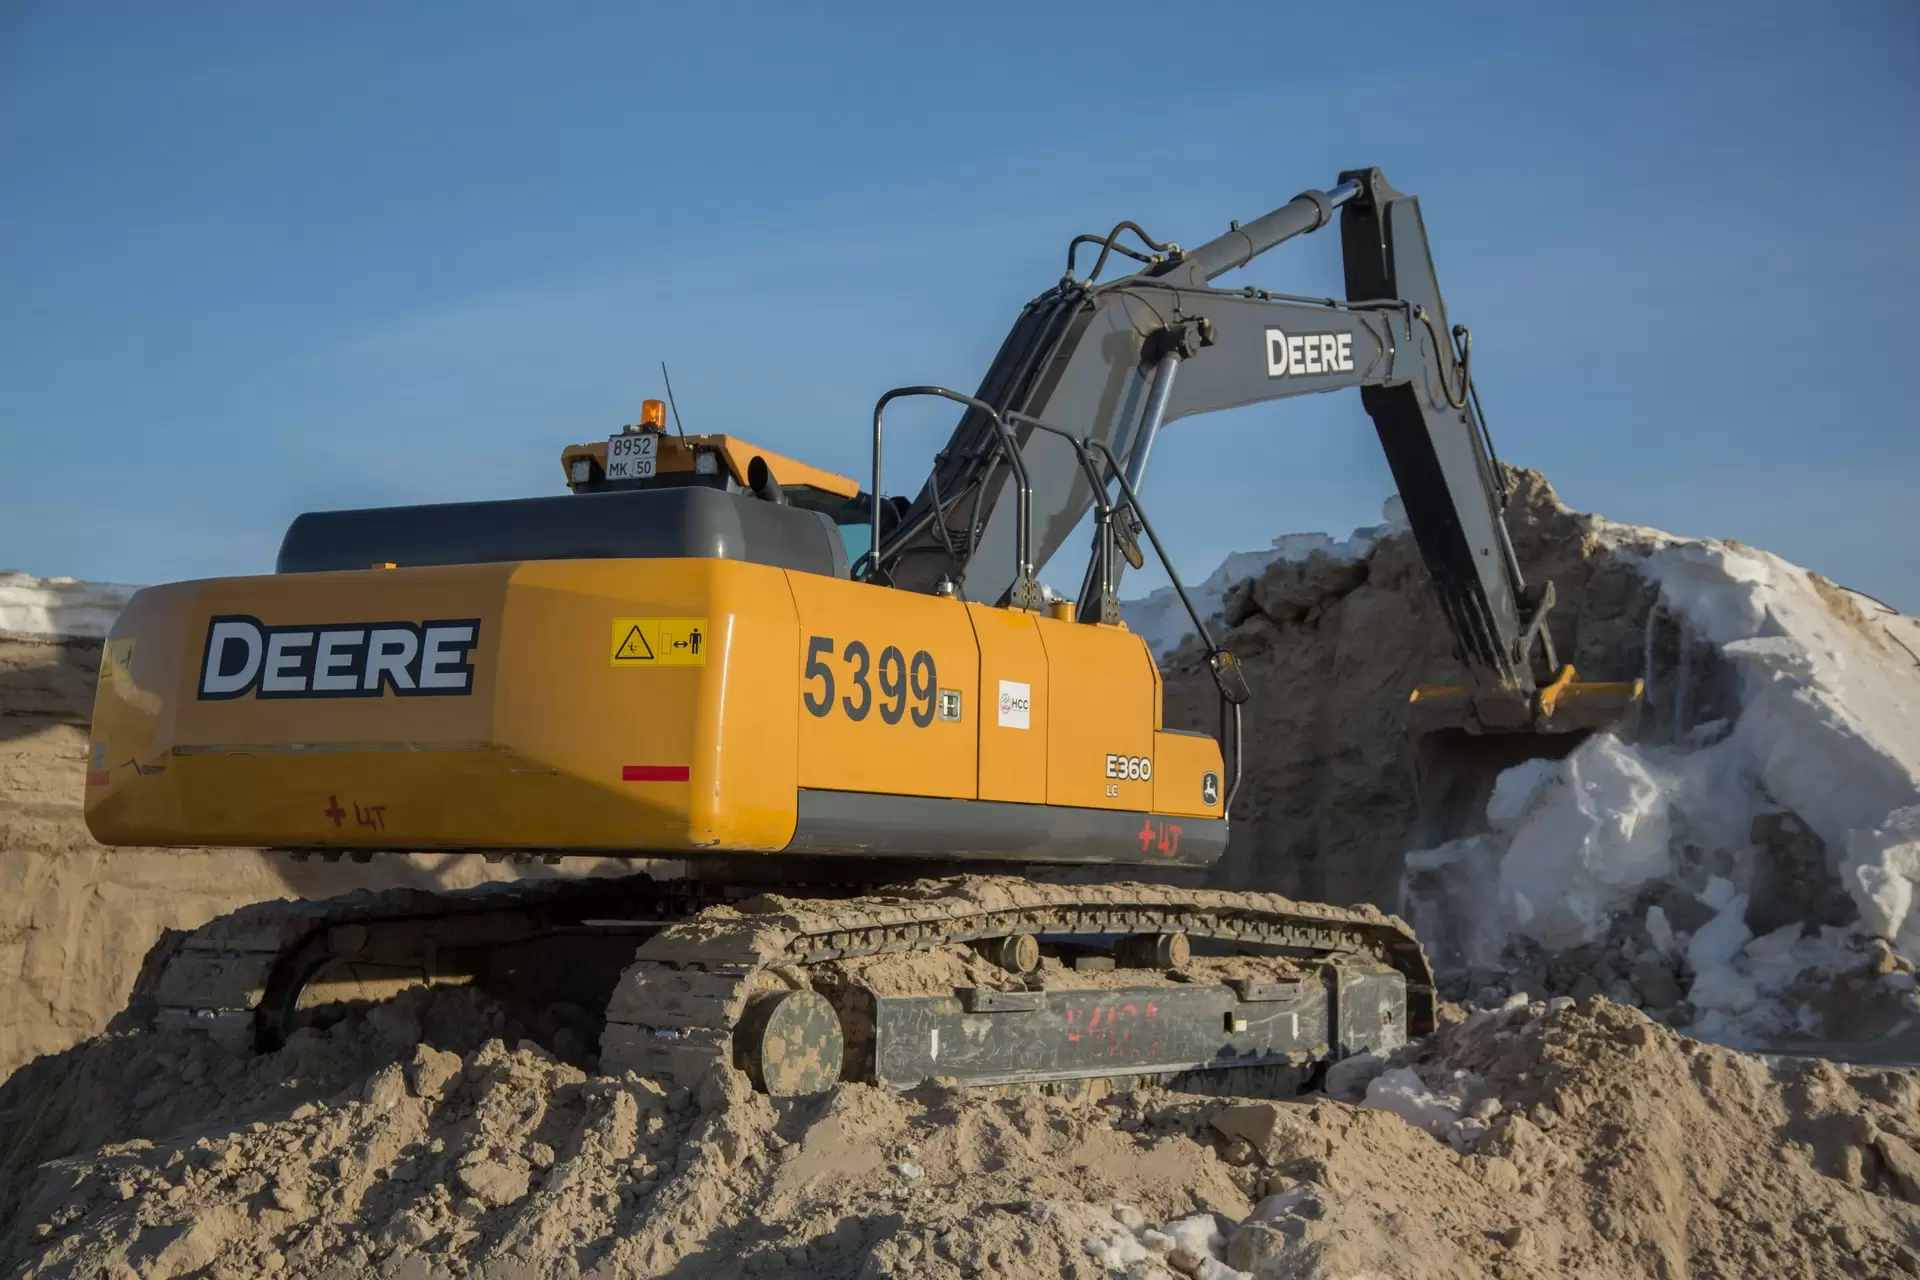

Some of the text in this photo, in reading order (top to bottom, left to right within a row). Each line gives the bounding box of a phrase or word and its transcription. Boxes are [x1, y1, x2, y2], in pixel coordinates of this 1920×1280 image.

[1265, 328, 1354, 377] DEERE
[613, 438, 651, 456] 8952
[636, 460, 651, 474] 50
[203, 621, 474, 693] DEERE
[803, 635, 937, 729] 5399
[1106, 754, 1152, 781] E360
[1106, 784, 1118, 797] LC
